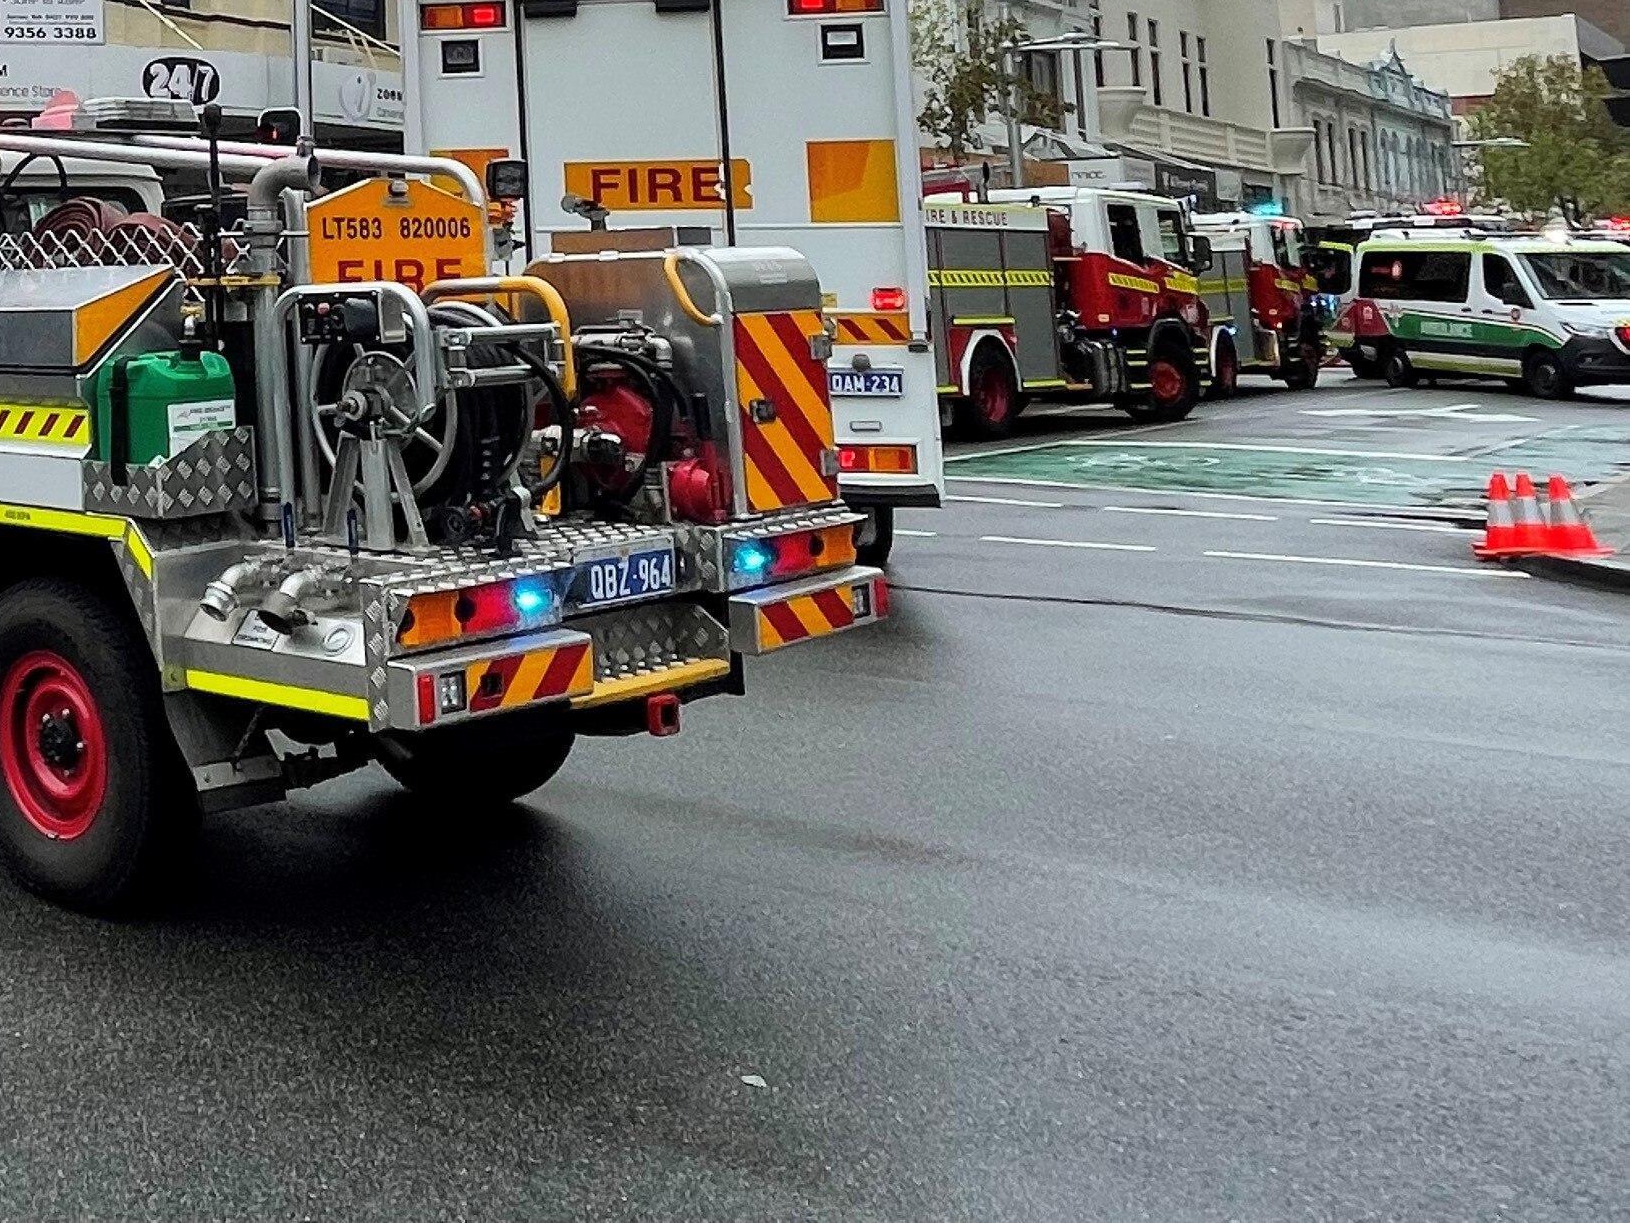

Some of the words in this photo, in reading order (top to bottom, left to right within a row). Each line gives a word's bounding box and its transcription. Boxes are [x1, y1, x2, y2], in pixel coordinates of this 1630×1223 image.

[4, 27, 47, 39] 9356
[54, 27, 97, 39] 3388
[150, 63, 214, 102] 24/7
[592, 167, 722, 204] FIRE
[323, 217, 383, 240] LT583
[400, 217, 471, 240] 820006
[963, 210, 1008, 226] RESCUE
[338, 258, 462, 295] FIRE
